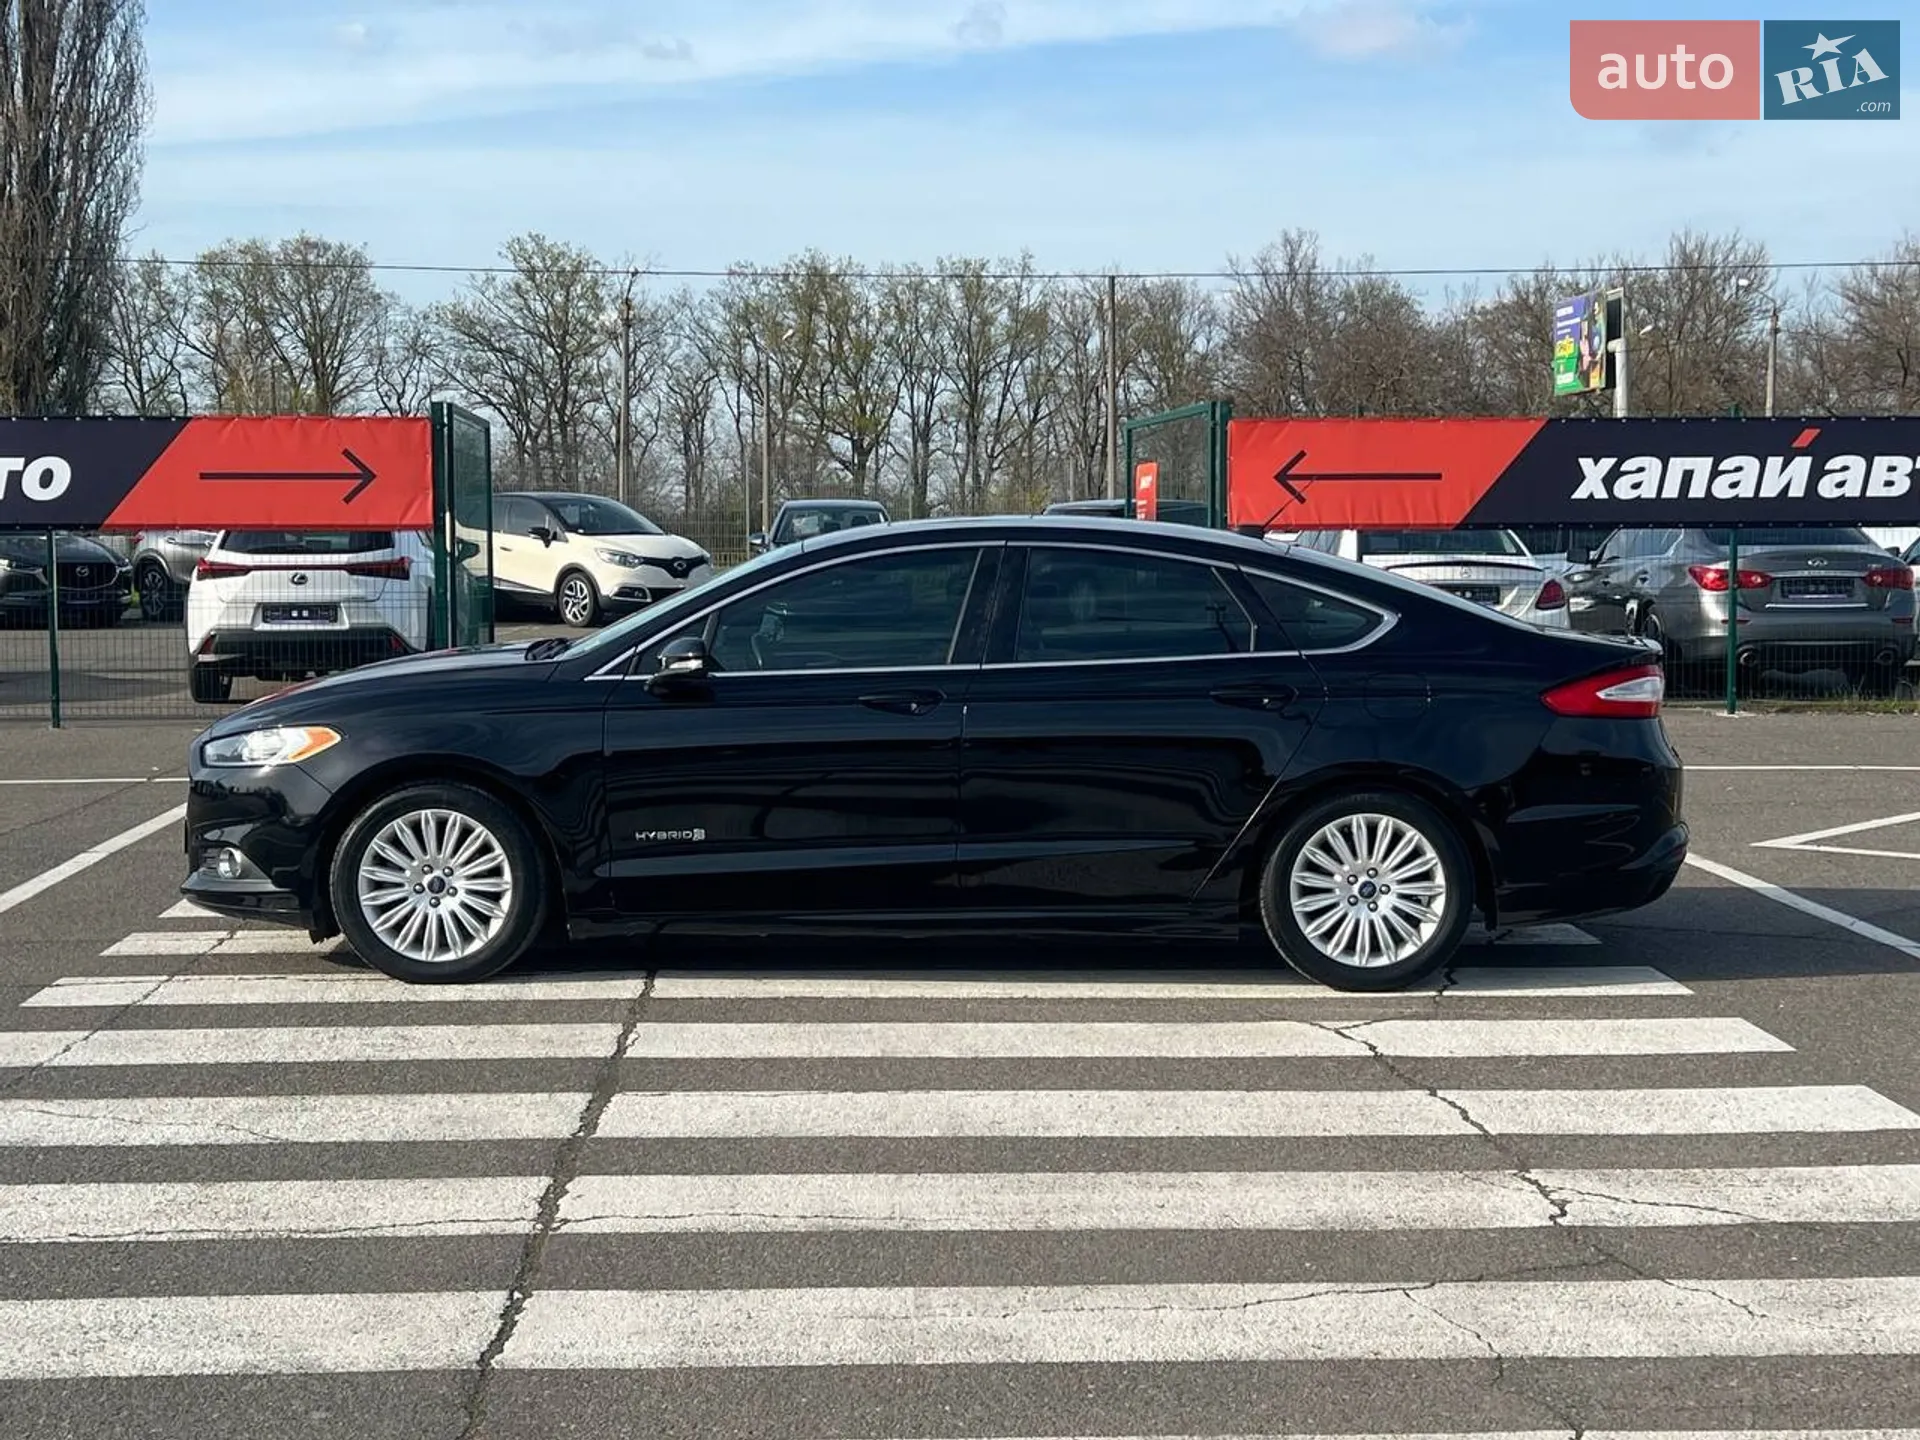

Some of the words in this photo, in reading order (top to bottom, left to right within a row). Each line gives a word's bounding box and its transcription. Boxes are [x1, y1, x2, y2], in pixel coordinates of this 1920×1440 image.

[1571, 428, 1821, 499] хапай
[1817, 455, 1920, 499] ав
[635, 830, 693, 841] HYBRID
